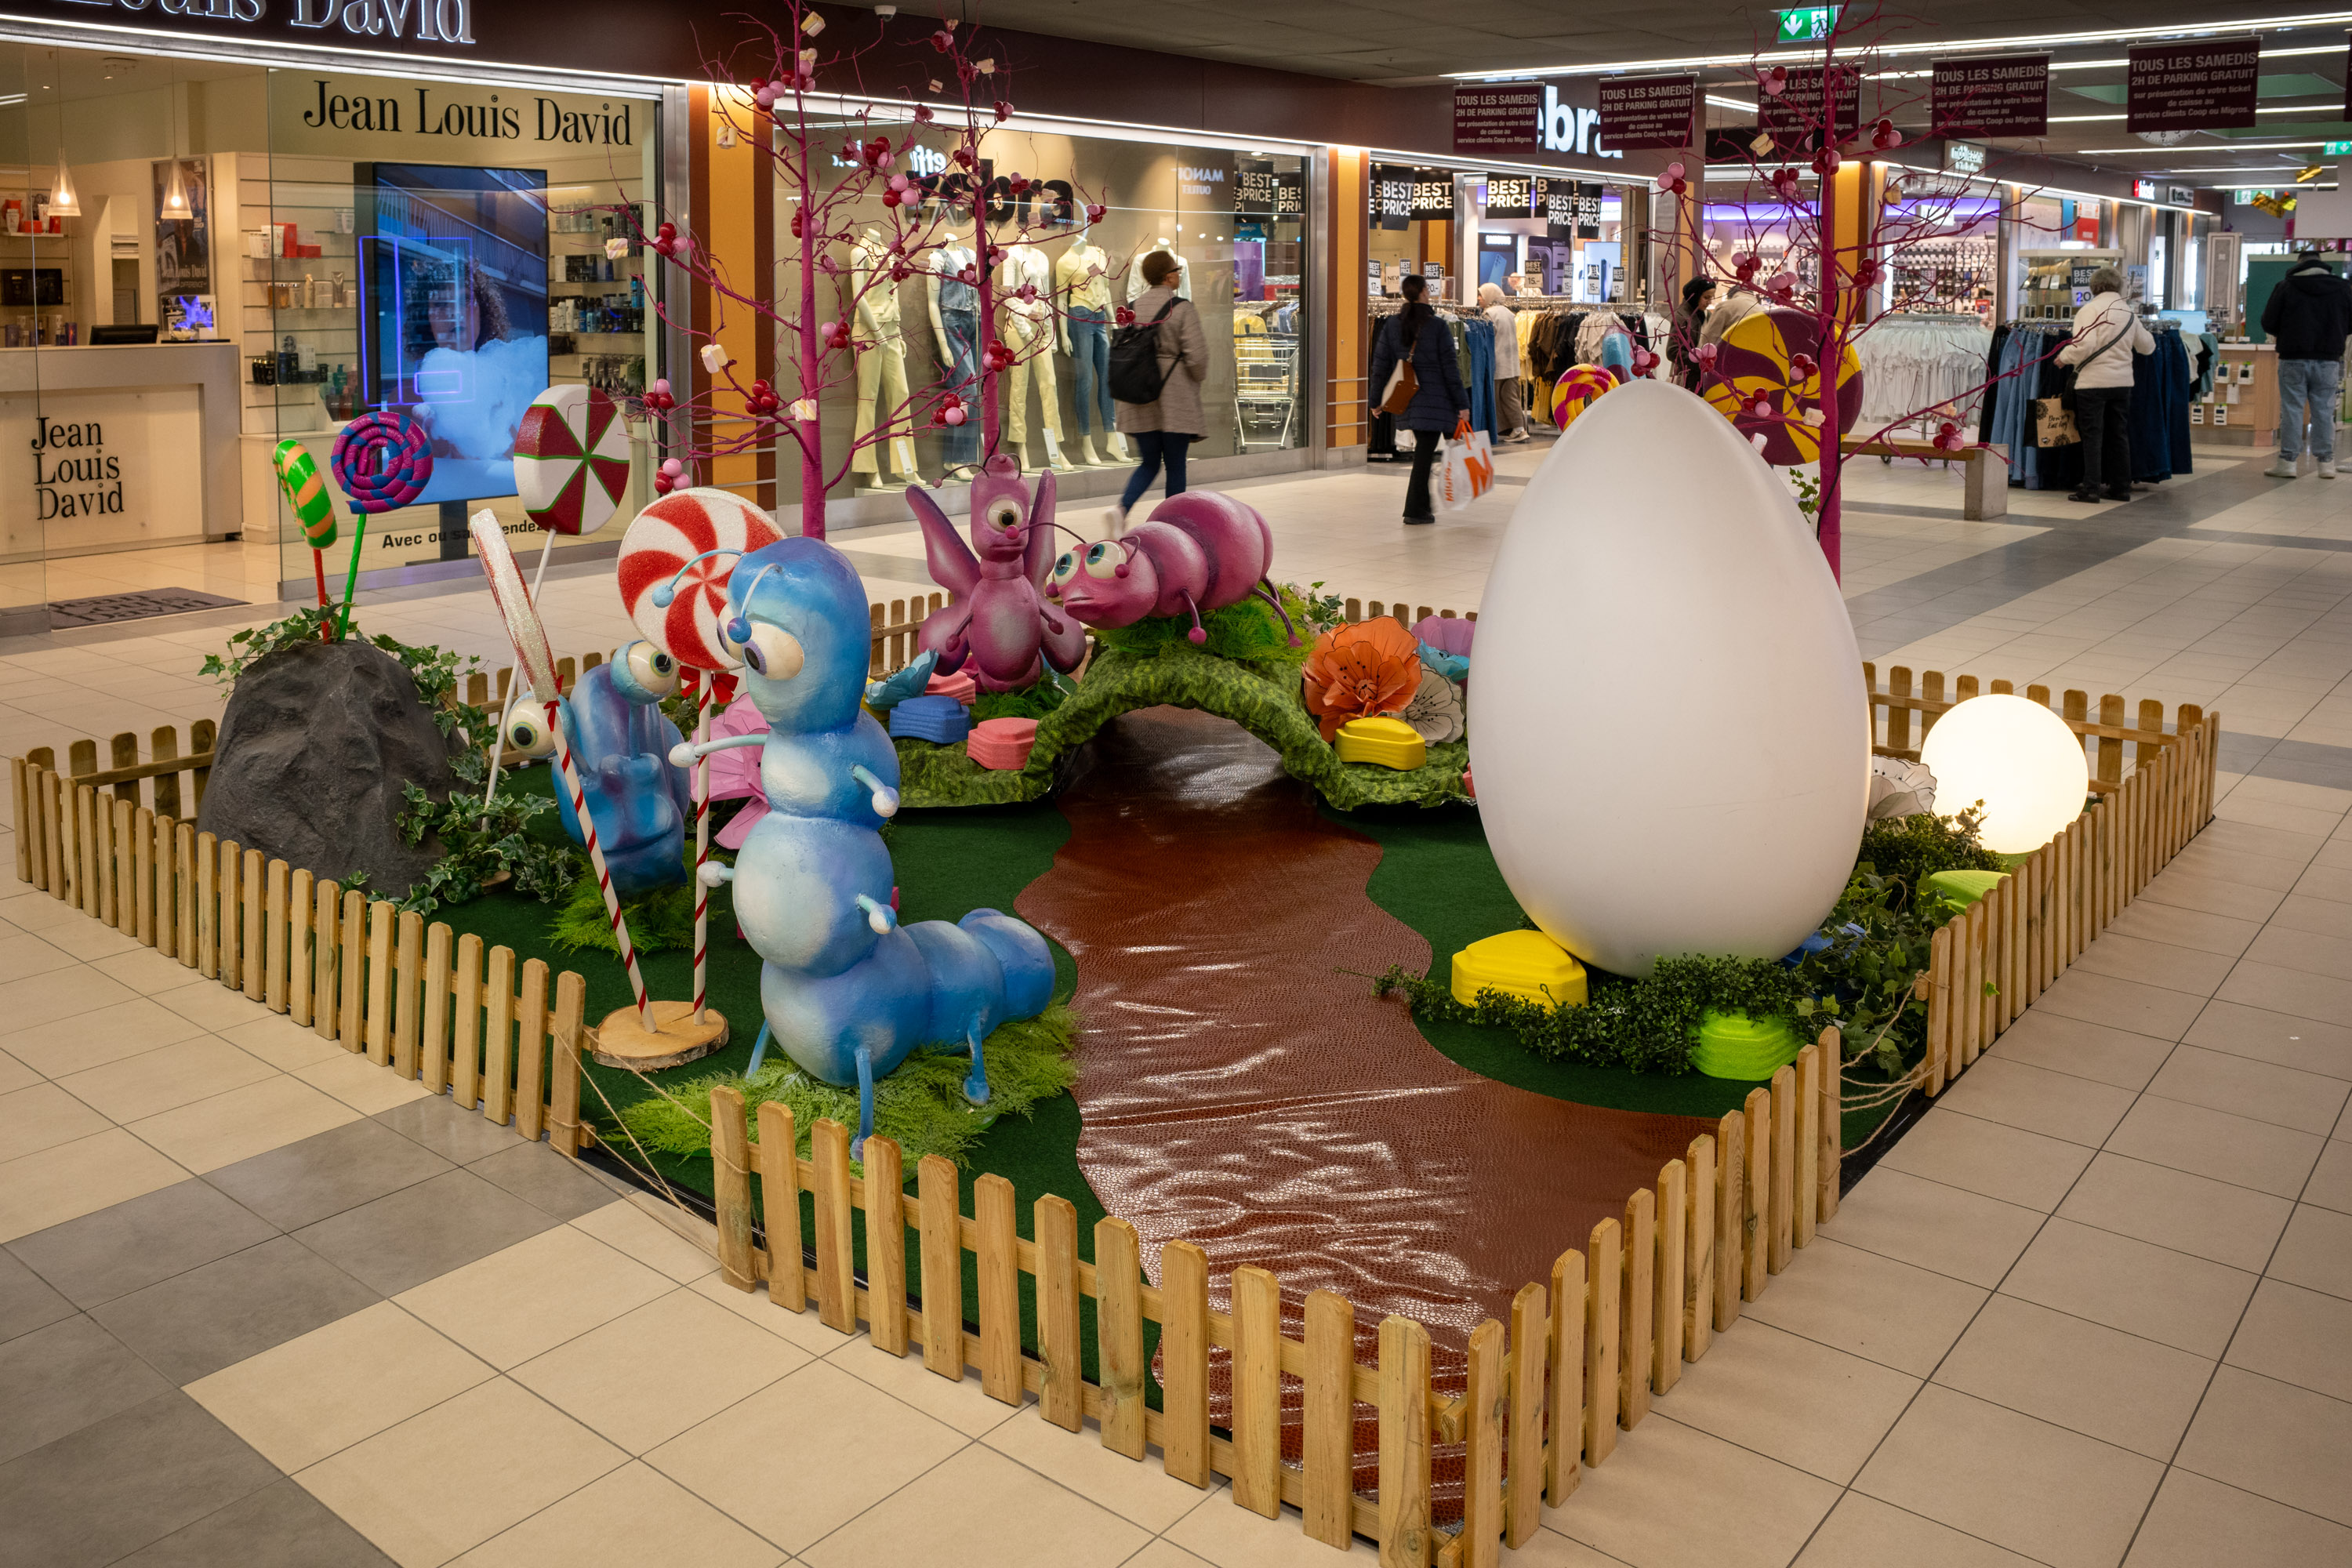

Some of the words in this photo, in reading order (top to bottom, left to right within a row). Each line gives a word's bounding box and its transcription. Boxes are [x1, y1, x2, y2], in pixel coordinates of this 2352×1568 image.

[2131, 59, 2164, 72] TOUS
[2168, 56, 2192, 70] LES
[2195, 52, 2257, 67] SAMEDIS
[1935, 71, 1964, 82] TOUS
[1968, 69, 1989, 81] LES
[1992, 65, 2046, 79] SAMEDIS
[2132, 77, 2145, 85] 2H
[2147, 75, 2161, 85] DE
[2164, 71, 2208, 83] PARKING
[2211, 68, 2256, 81] GRATUIT
[1602, 89, 1626, 100] TOUS
[1629, 88, 1646, 98] LES
[1649, 85, 1692, 97] SAMEDIS
[1935, 87, 1947, 96] 2H
[1949, 86, 1961, 95] DE
[2005, 81, 2045, 91] GRATUIT
[2147, 89, 2194, 99] présentation
[1456, 96, 1479, 105] TOUS
[1481, 95, 1497, 105] LES
[1499, 94, 1537, 104] SAMEDIS
[1625, 100, 1657, 110] PARKING
[1660, 99, 1691, 108] GRATUIT
[1761, 95, 1770, 103] 2H
[304, 80, 401, 132] Jean
[414, 89, 520, 139] Louis
[534, 97, 633, 145] David
[2133, 111, 2160, 119] service
[2187, 108, 2207, 117] Coop
[1986, 117, 2003, 125] Coop
[1243, 172, 1272, 188] BEST
[1488, 180, 1530, 194] BEST
[1243, 188, 1272, 202] PRICE
[1383, 180, 1413, 199] BEST
[1413, 183, 1452, 197] BEST
[1279, 201, 1301, 212] PRI
[1383, 199, 1411, 216] PRICE
[1412, 197, 1452, 209] PRICE
[1487, 194, 1530, 208] PRICE
[1548, 194, 1573, 210] BEST
[1579, 197, 1601, 212] BEST
[1548, 211, 1573, 226] PRICE
[1578, 212, 1600, 227] PRICE
[31, 417, 103, 449] Jean
[33, 448, 119, 485] Louis
[36, 481, 124, 520] David
[383, 535, 422, 549] Avec
[429, 532, 446, 543] ou
[452, 530, 477, 539] sa
